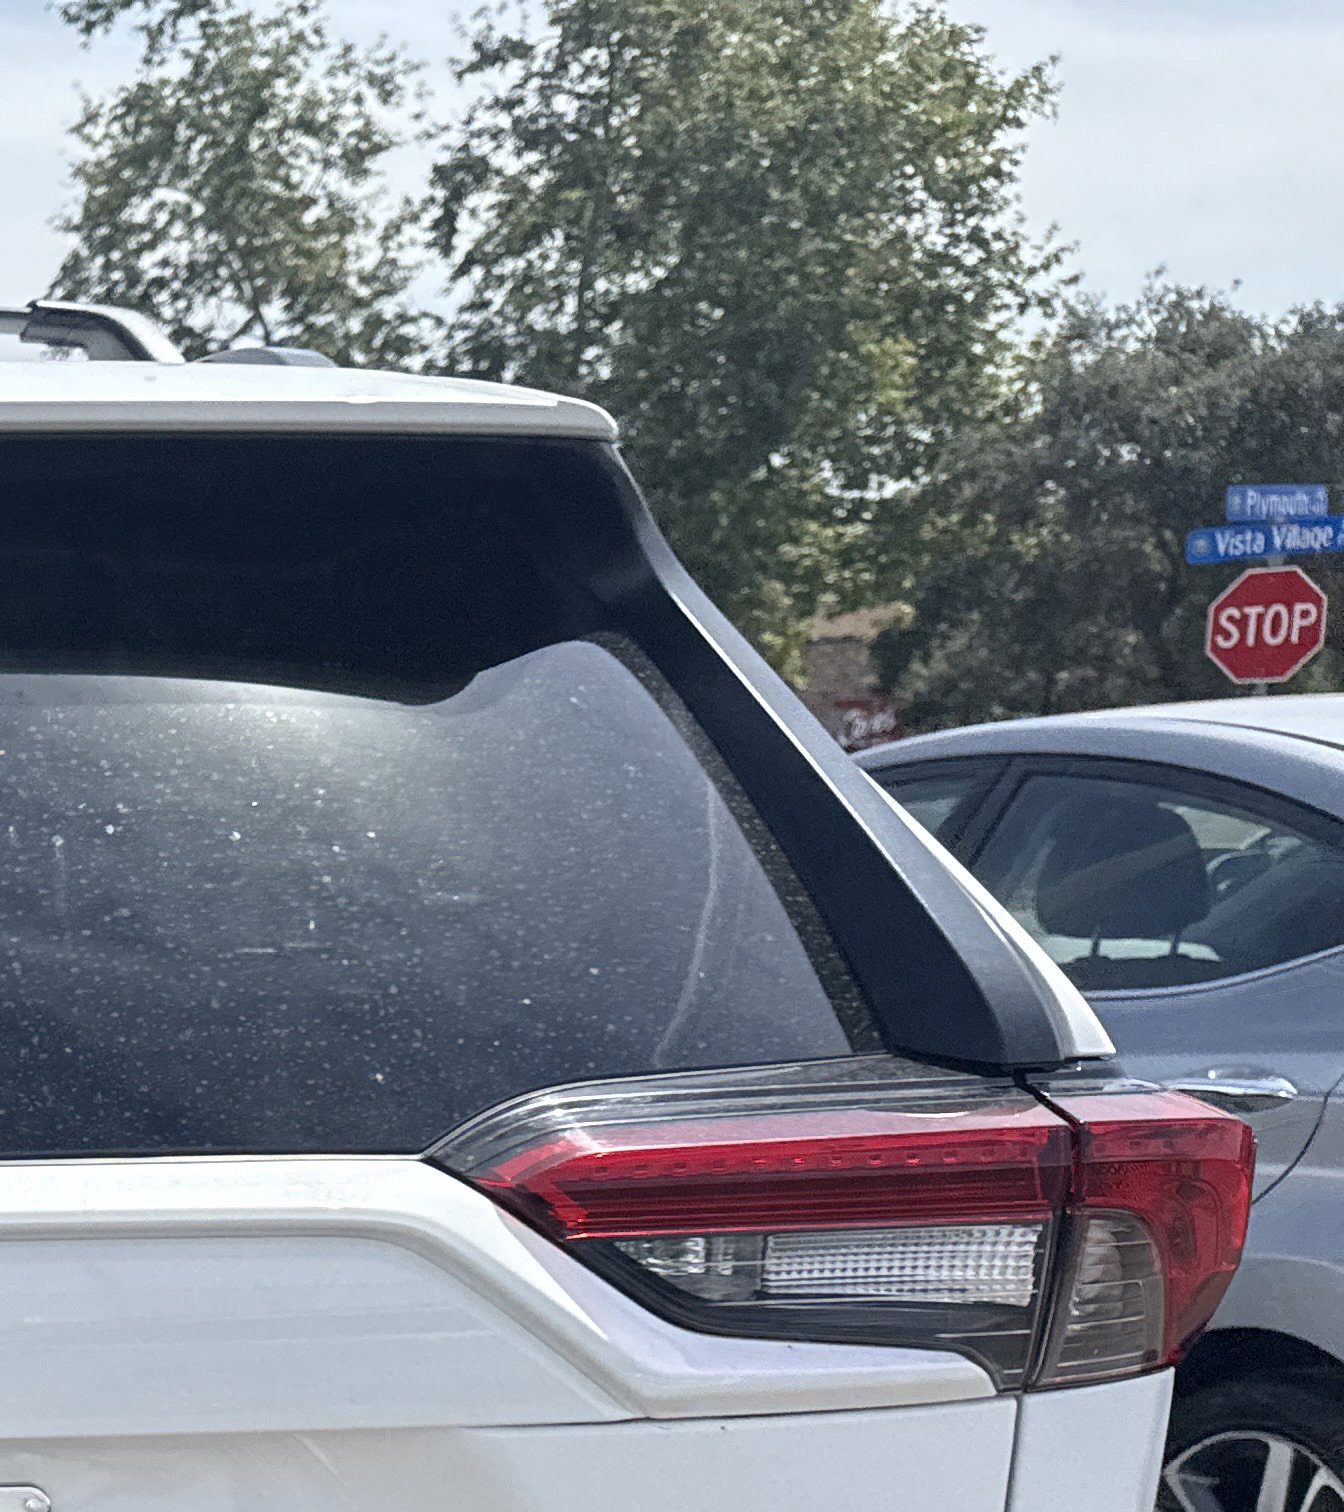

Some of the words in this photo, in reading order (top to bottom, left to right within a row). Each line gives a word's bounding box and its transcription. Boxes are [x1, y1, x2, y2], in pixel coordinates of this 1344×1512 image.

[1214, 528, 1266, 557] Vista
[1272, 523, 1333, 552] Village
[1215, 602, 1318, 649] STOP
